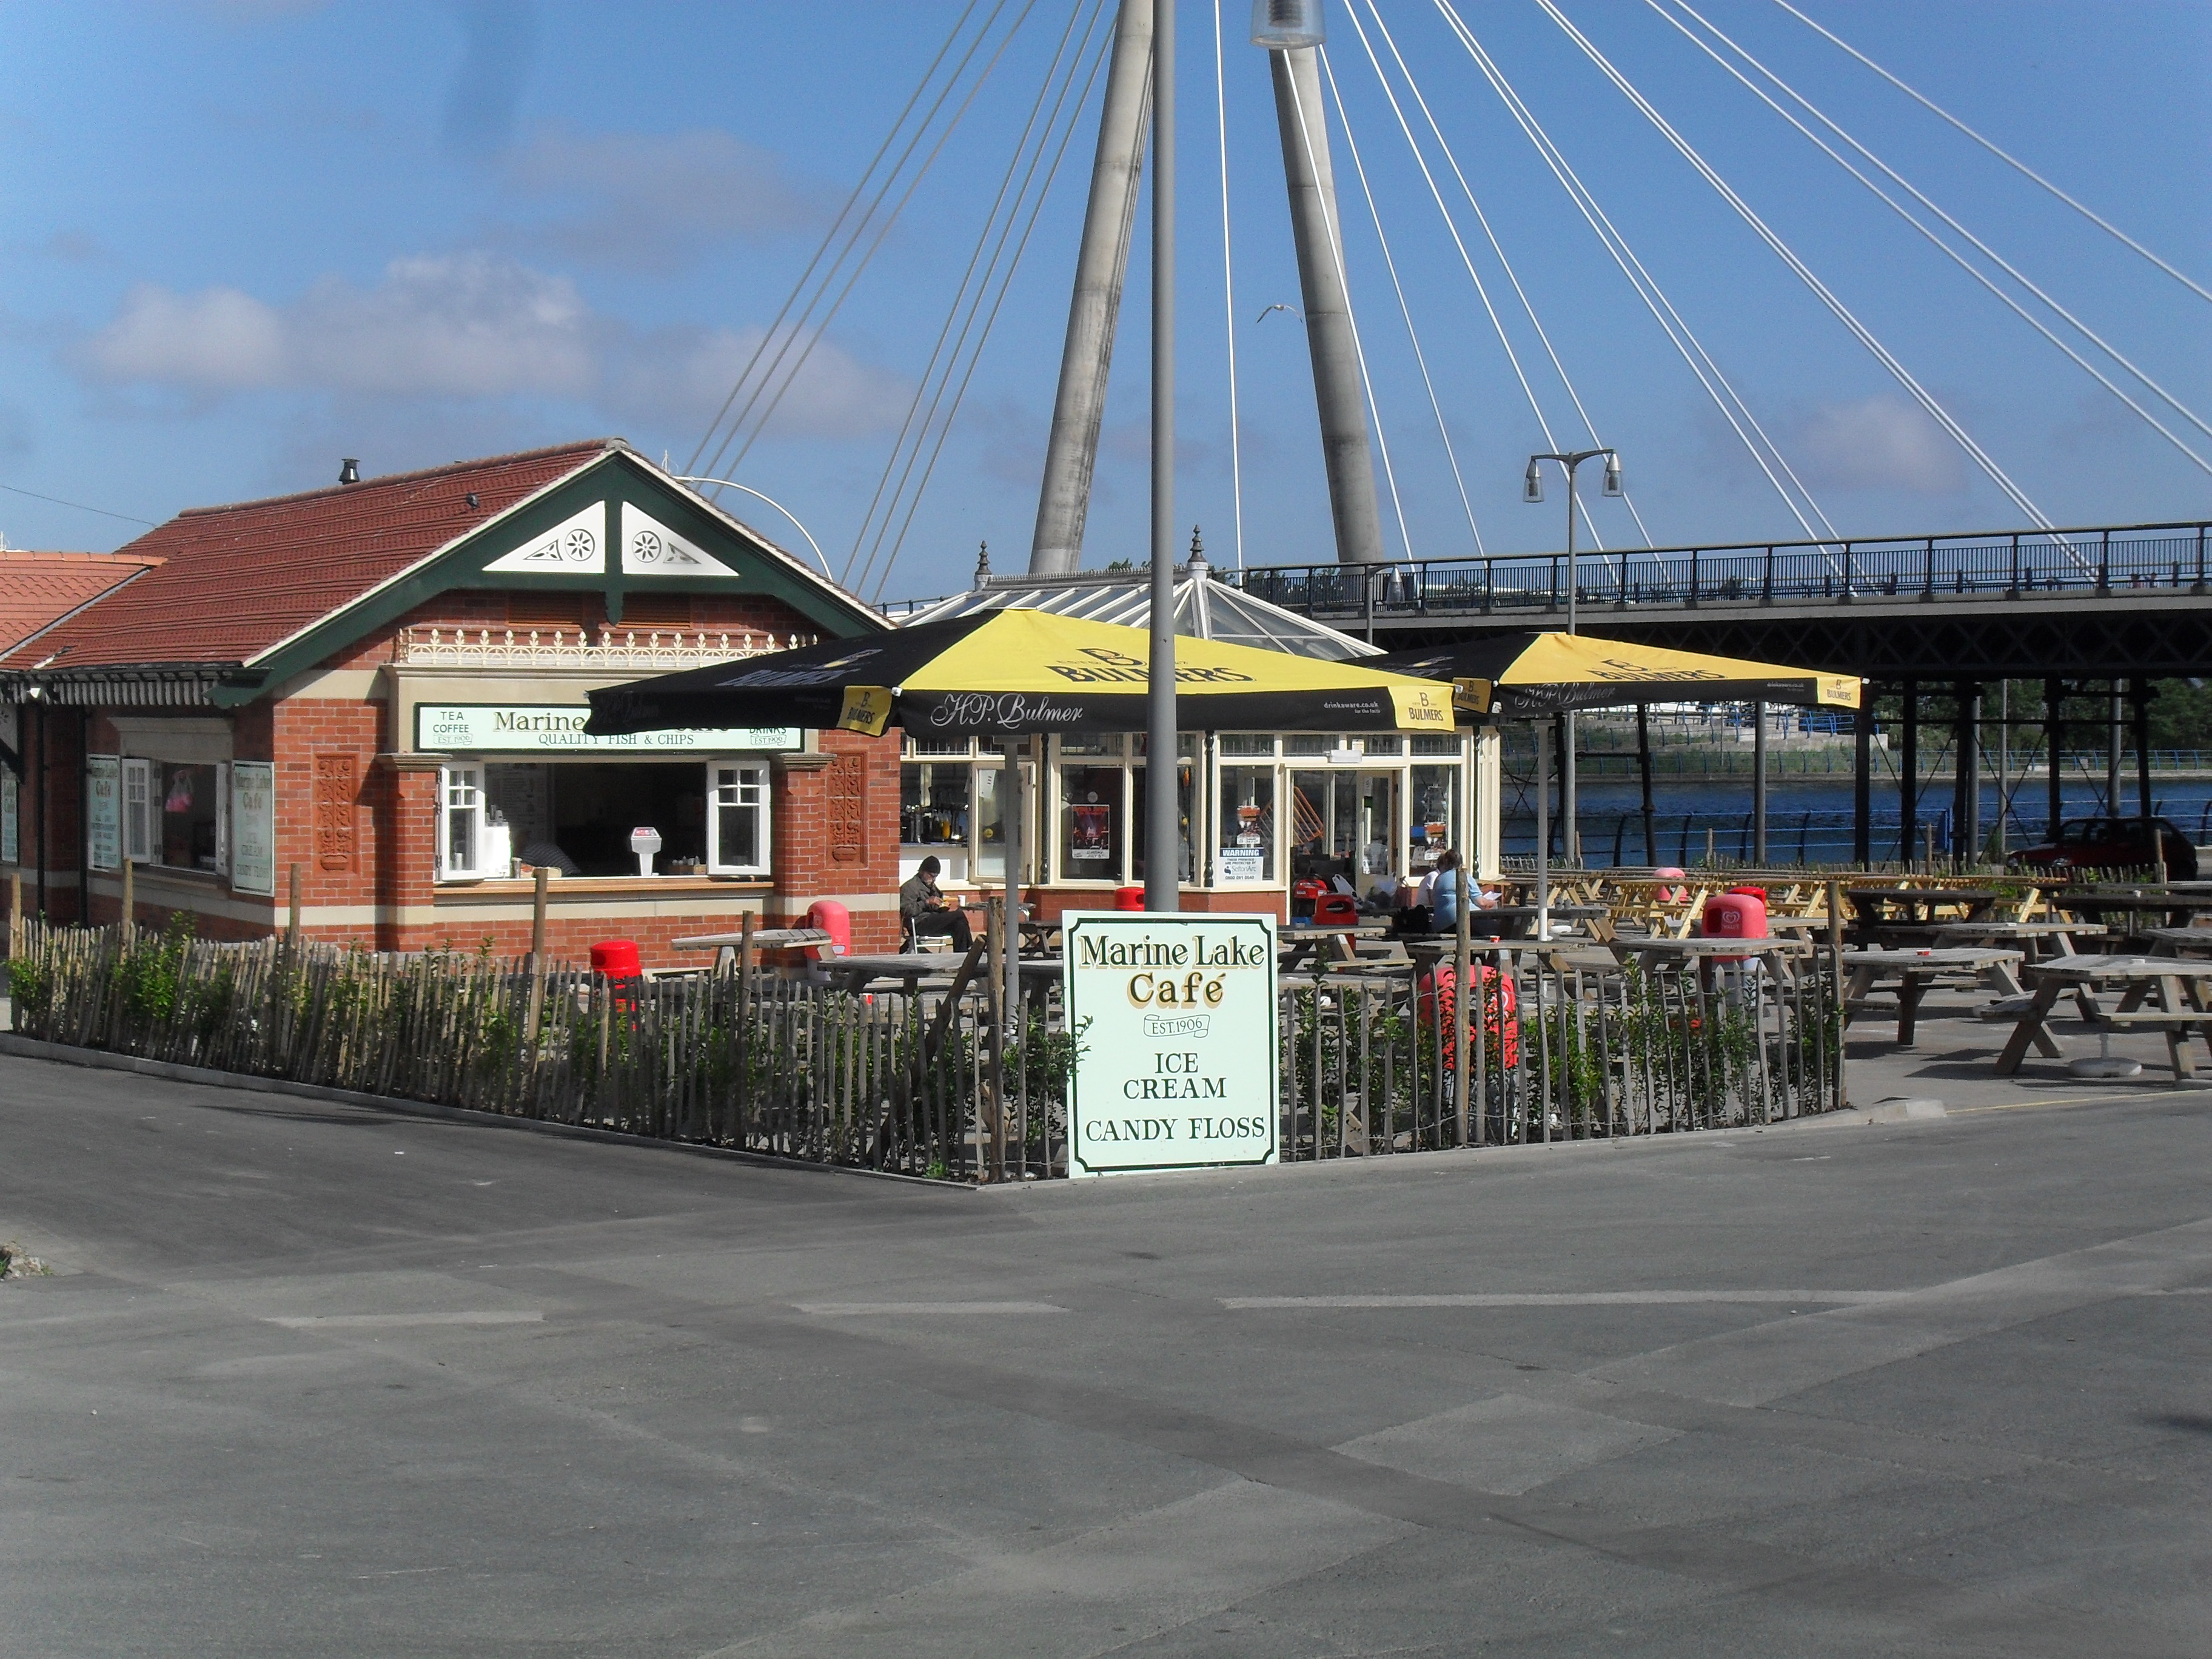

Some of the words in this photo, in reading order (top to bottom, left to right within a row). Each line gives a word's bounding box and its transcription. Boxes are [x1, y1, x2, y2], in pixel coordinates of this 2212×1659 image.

[1044, 665, 1256, 683] BULERS
[1586, 669, 1728, 680] BULMERS
[1826, 689, 1851, 701] BULMERS
[440, 711, 464, 720] TEA
[996, 693, 1083, 729] Bulmer
[1408, 707, 1444, 722] BULMERS
[433, 724, 469, 733] COFFEE
[493, 711, 586, 732] Marine
[538, 734, 598, 746] QUALITY
[609, 734, 637, 745] FISH
[644, 734, 653, 745] &
[657, 734, 694, 745] CHIPS
[1079, 934, 1188, 969] Marine
[1192, 935, 1265, 968] Lake
[1127, 972, 1227, 1009] Café
[1155, 1053, 1199, 1074] ICE
[1123, 1077, 1227, 1099] CREAM
[1085, 1118, 1178, 1142] CANDY
[1188, 1116, 1265, 1139] FLOSS
